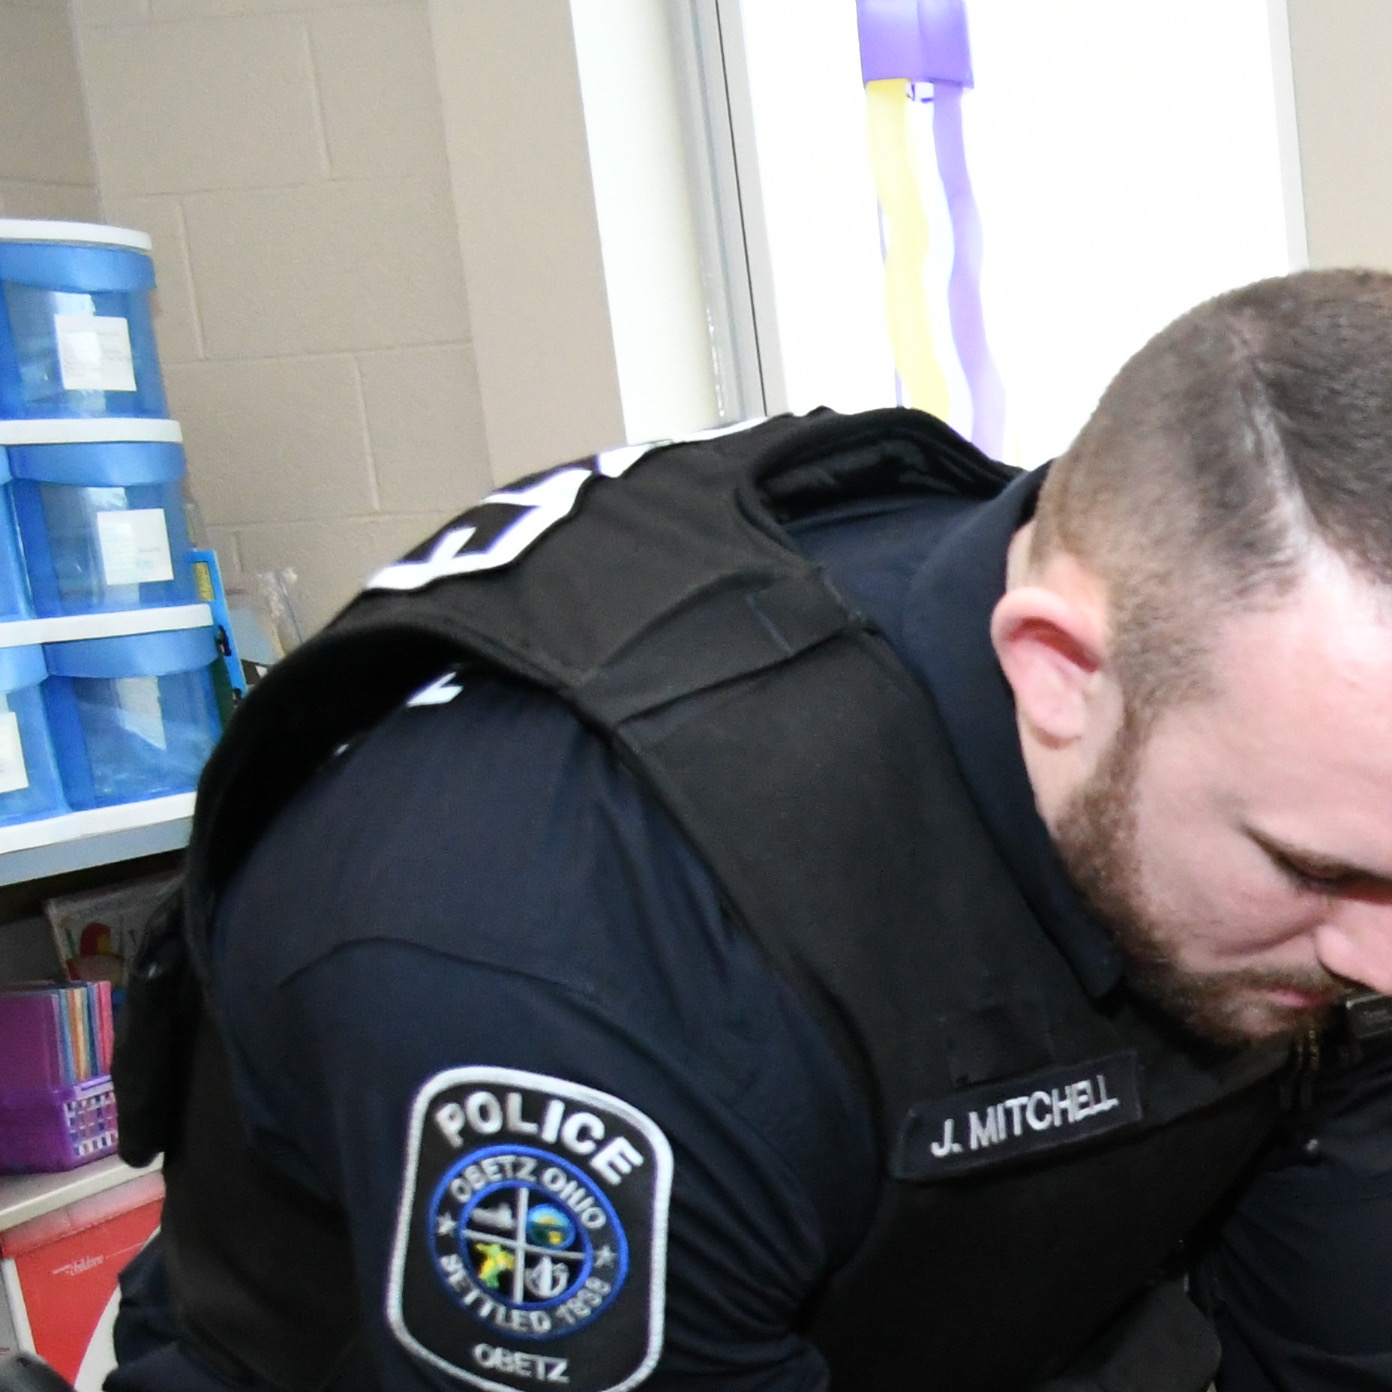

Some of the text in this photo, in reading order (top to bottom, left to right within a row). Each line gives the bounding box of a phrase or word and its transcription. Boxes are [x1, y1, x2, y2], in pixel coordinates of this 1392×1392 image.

[434, 1090, 645, 1186] POLICE
[930, 1074, 1120, 1157] J. MITCHELL
[449, 1154, 607, 1230] OBETZ OHIO
[439, 1253, 552, 1334] SETTLED
[471, 1343, 570, 1384] OBETZ
